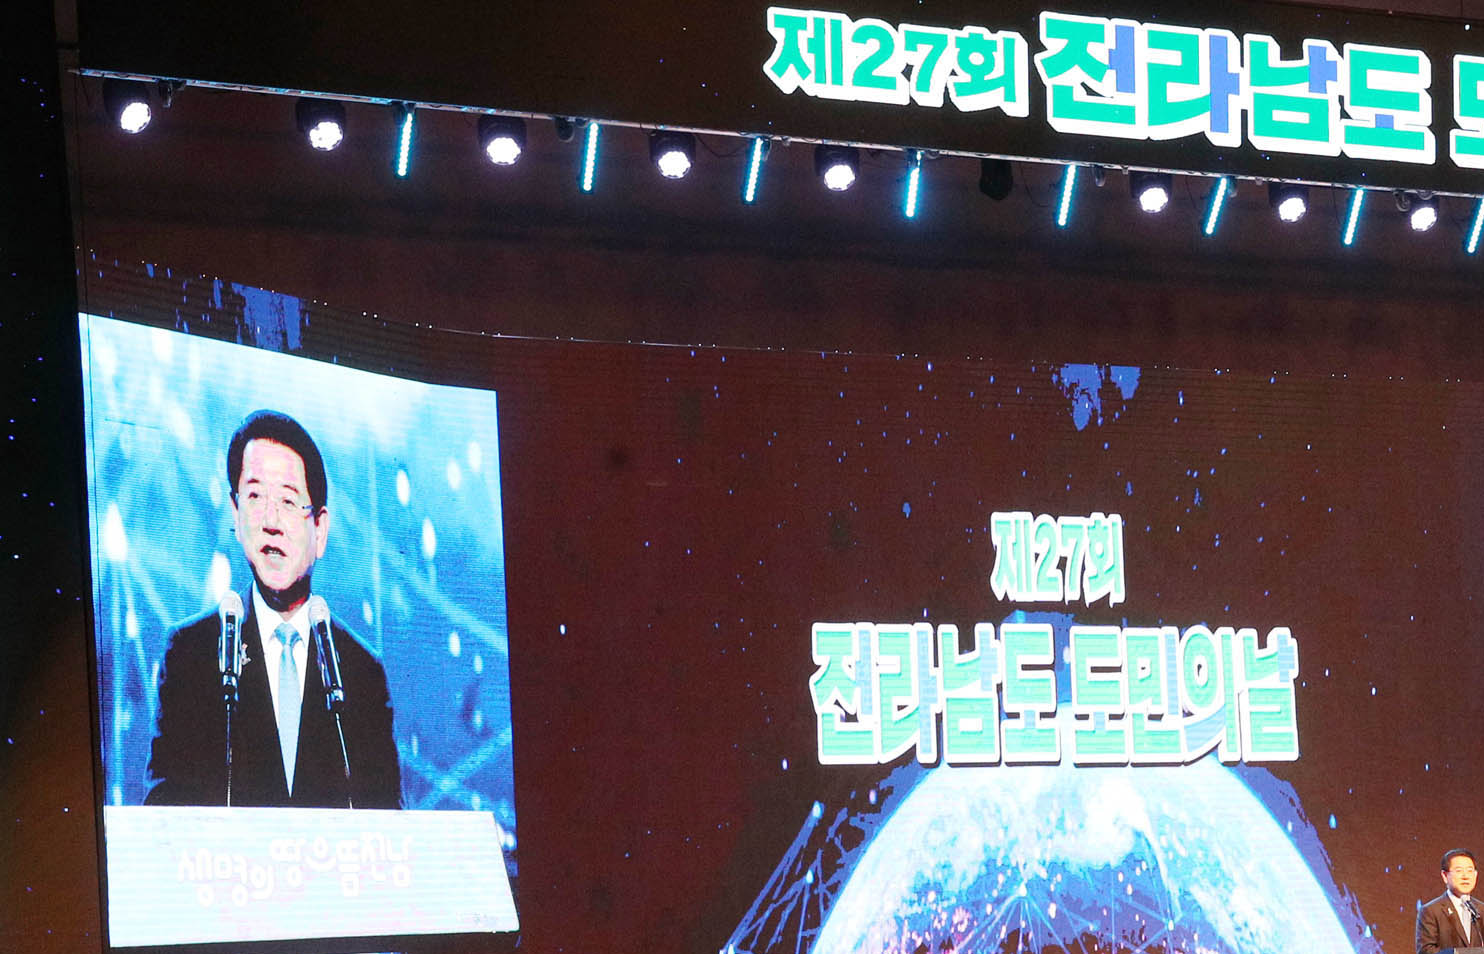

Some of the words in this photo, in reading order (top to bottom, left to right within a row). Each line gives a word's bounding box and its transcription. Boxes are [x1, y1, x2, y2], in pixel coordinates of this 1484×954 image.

[764, 7, 1029, 117] 제27회
[1035, 11, 1436, 164] 전라남도
[289, 297, 320, 327] 가
[990, 511, 1126, 608] 제27회
[809, 622, 1062, 765] 전라남도
